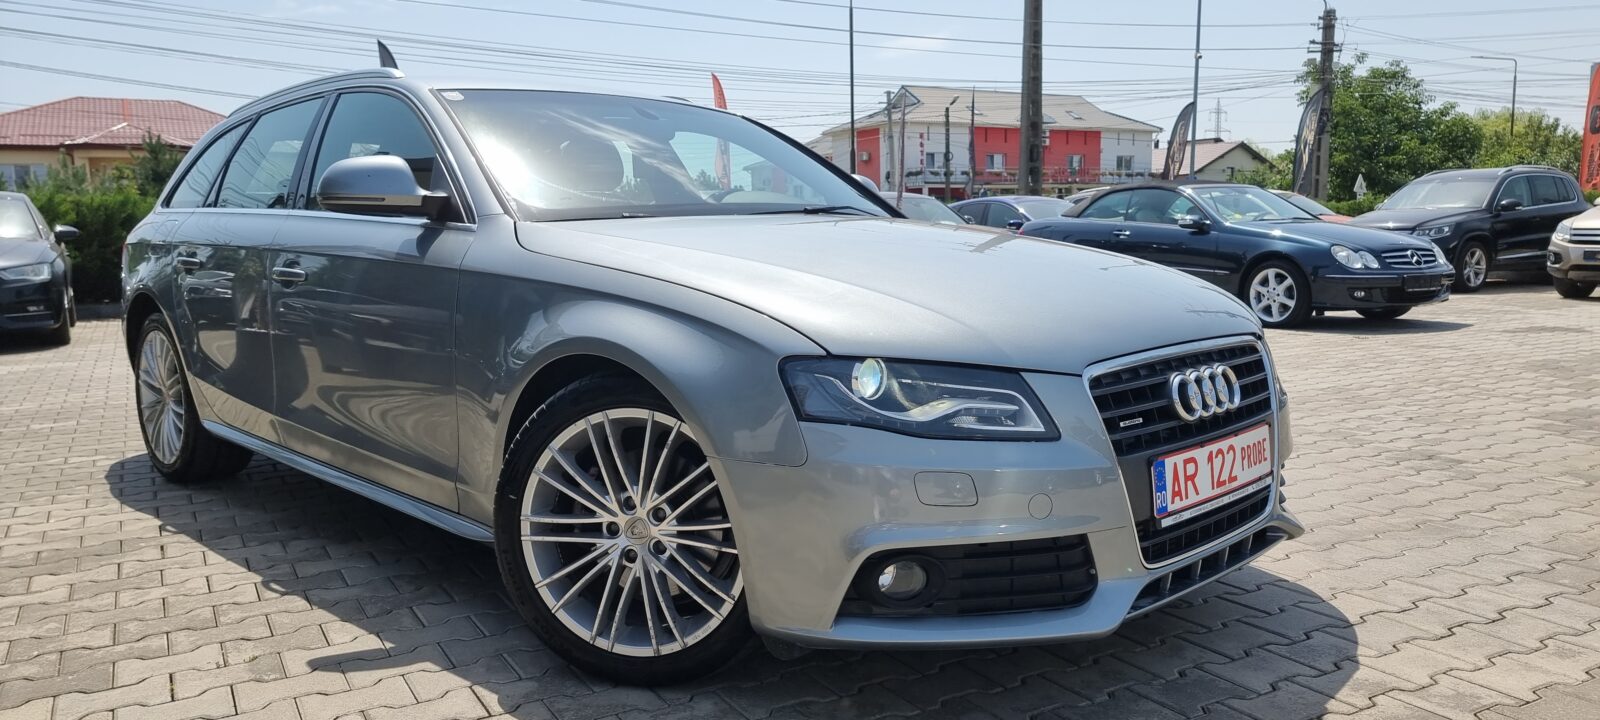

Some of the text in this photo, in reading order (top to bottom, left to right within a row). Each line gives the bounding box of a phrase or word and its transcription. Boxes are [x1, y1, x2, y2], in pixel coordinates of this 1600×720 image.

[1171, 438, 1267, 505] AR 122 PROBE
[1156, 491, 1167, 509] RO
